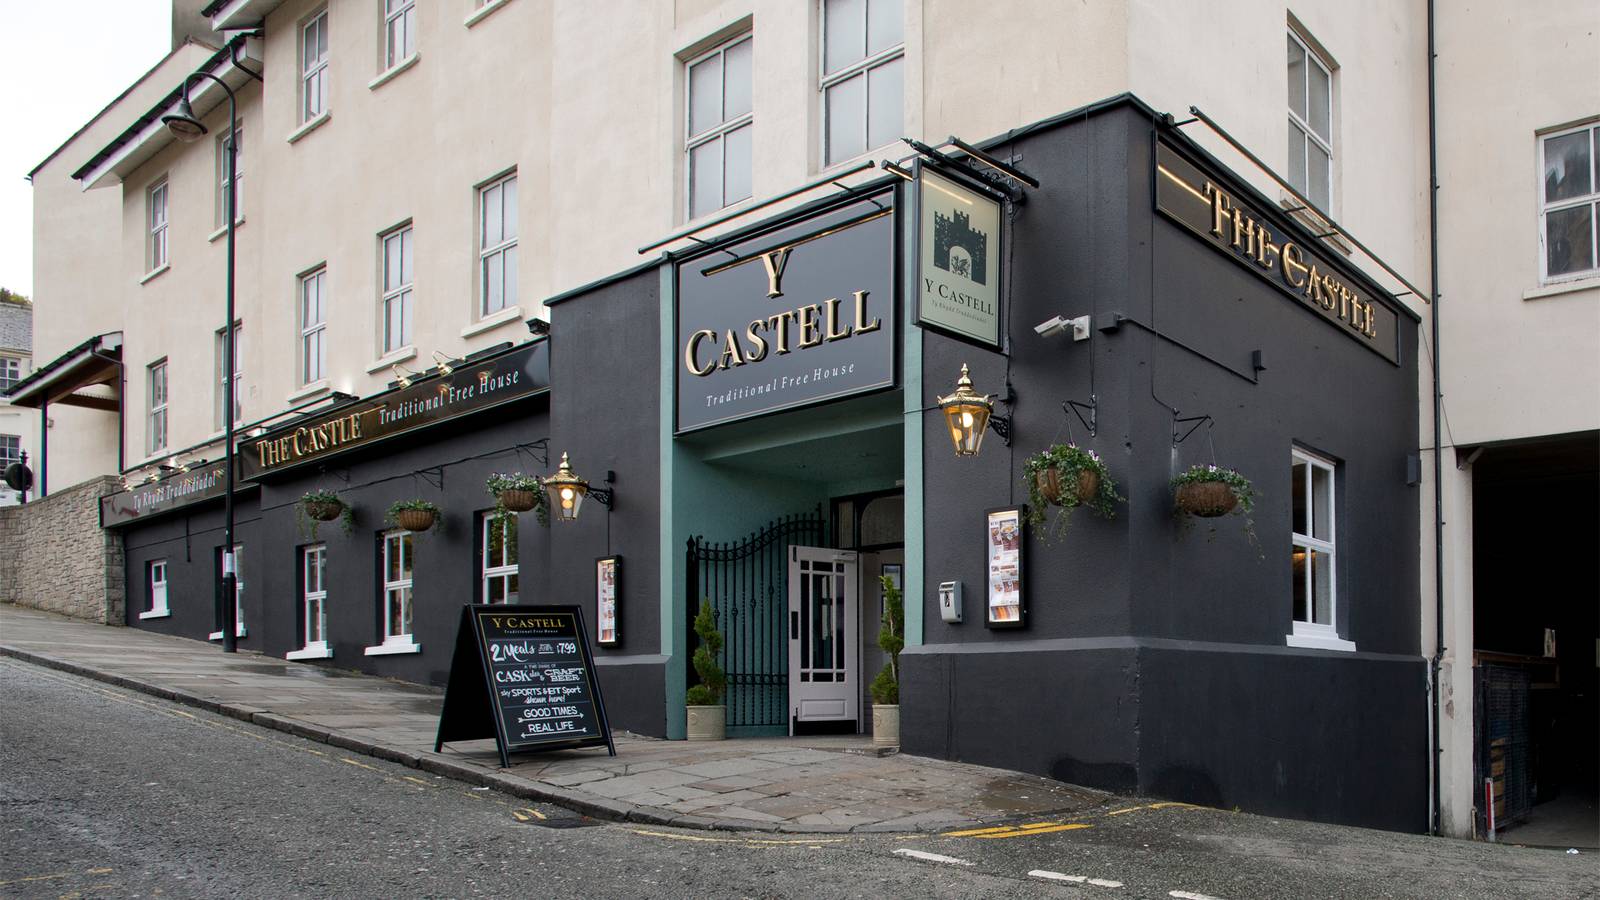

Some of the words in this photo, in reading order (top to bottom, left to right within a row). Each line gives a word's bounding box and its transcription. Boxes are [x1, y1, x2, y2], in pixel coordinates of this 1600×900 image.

[1203, 181, 1273, 270] THE
[1280, 242, 1376, 339] CASTLE
[761, 247, 794, 299] Y
[924, 278, 934, 293] Y
[938, 284, 994, 316] CASTELL
[685, 290, 881, 377] CASTELL
[706, 379, 778, 407] Traditional
[781, 372, 809, 390] Free
[813, 362, 856, 381] House
[257, 435, 291, 467] THE
[294, 413, 363, 456] CASTLE
[379, 390, 444, 425] Traditional
[449, 385, 475, 404] Free
[479, 368, 520, 395] House
[492, 617, 502, 628] Y
[506, 618, 565, 628] CASTELL
[490, 644, 505, 662] 2
[504, 641, 535, 662] Meals
[496, 670, 532, 682] CASK
[544, 667, 584, 676] CRAFT
[550, 674, 580, 682] BEER
[511, 687, 540, 697] SPORTS
[562, 686, 581, 696] Sport
[523, 707, 551, 718] GOOD
[552, 706, 578, 715] TIMES
[528, 723, 554, 733] REAL
[556, 721, 574, 731] LIFE
